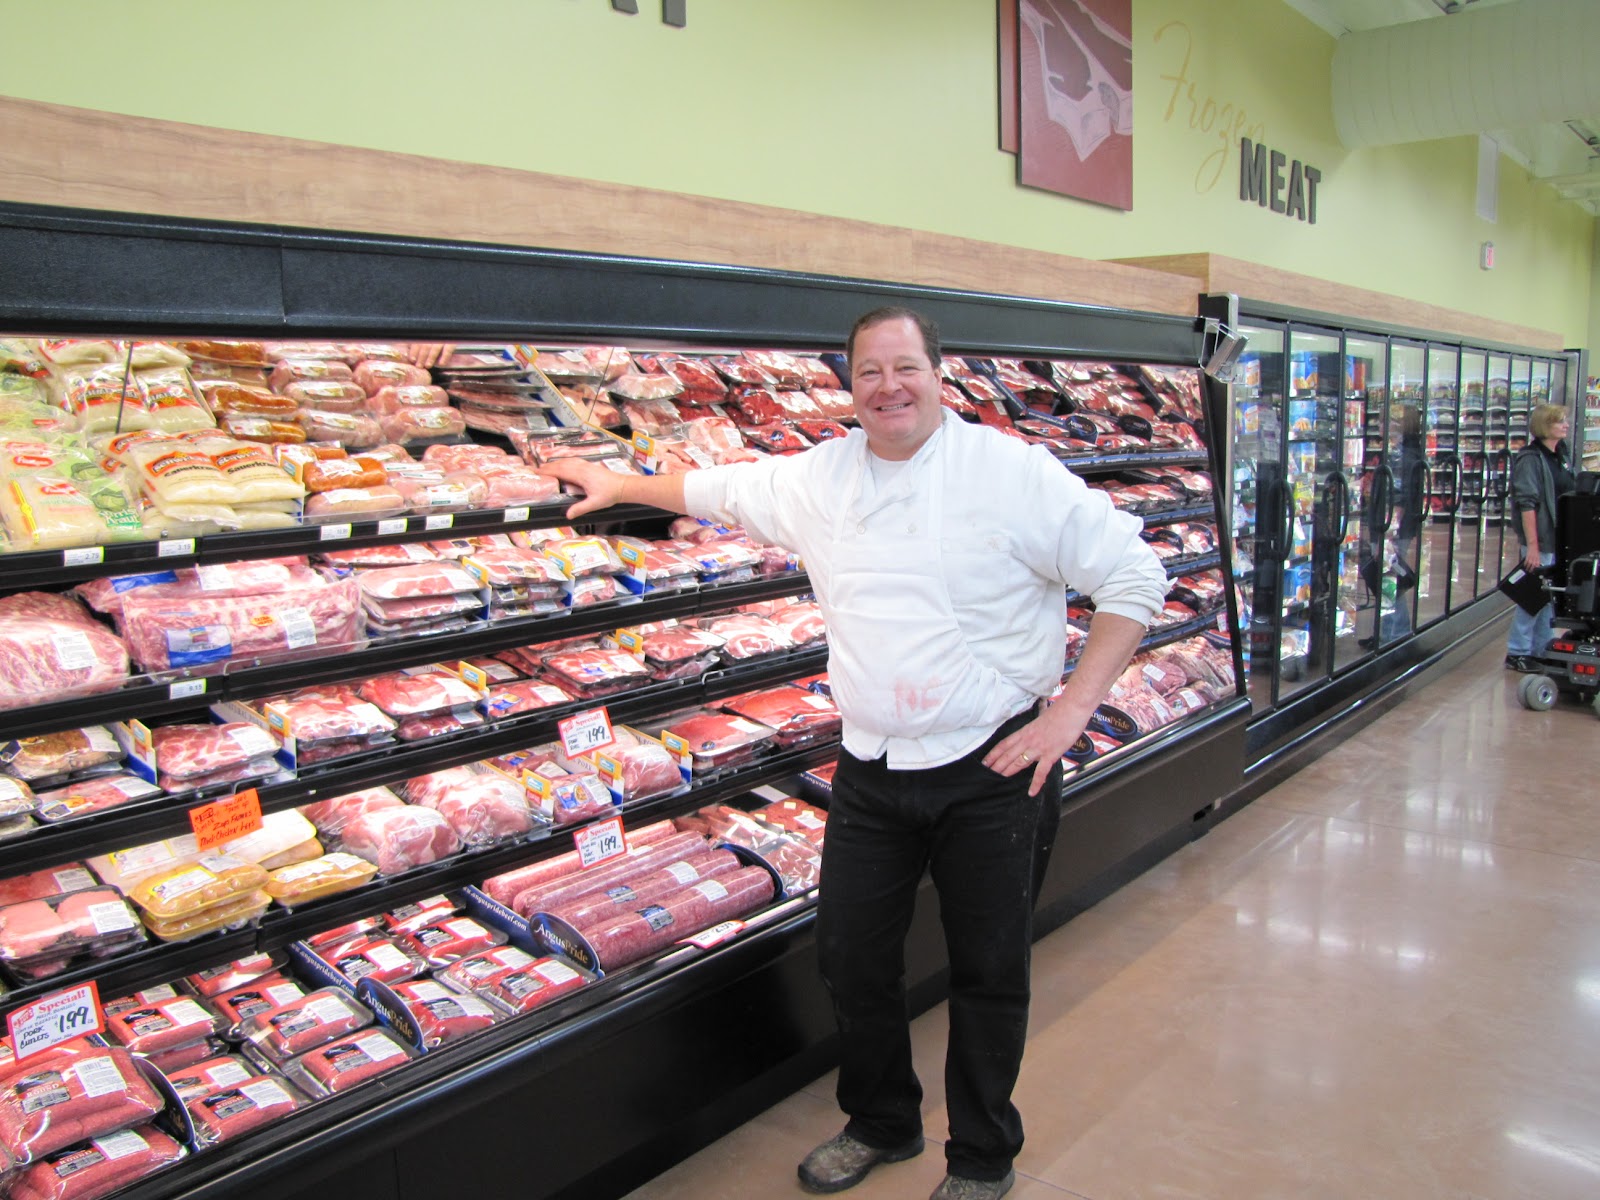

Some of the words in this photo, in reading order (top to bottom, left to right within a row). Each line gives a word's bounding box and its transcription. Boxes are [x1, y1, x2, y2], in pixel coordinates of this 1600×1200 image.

[1153, 20, 1265, 195] Frozen
[1239, 137, 1322, 225] MEAT
[1091, 712, 1131, 730] ngusPride
[38, 989, 87, 1013] Special!
[23, 1025, 44, 1040] PORK
[26, 1083, 59, 1097] ROUND
[59, 1150, 93, 1165] ROUND
